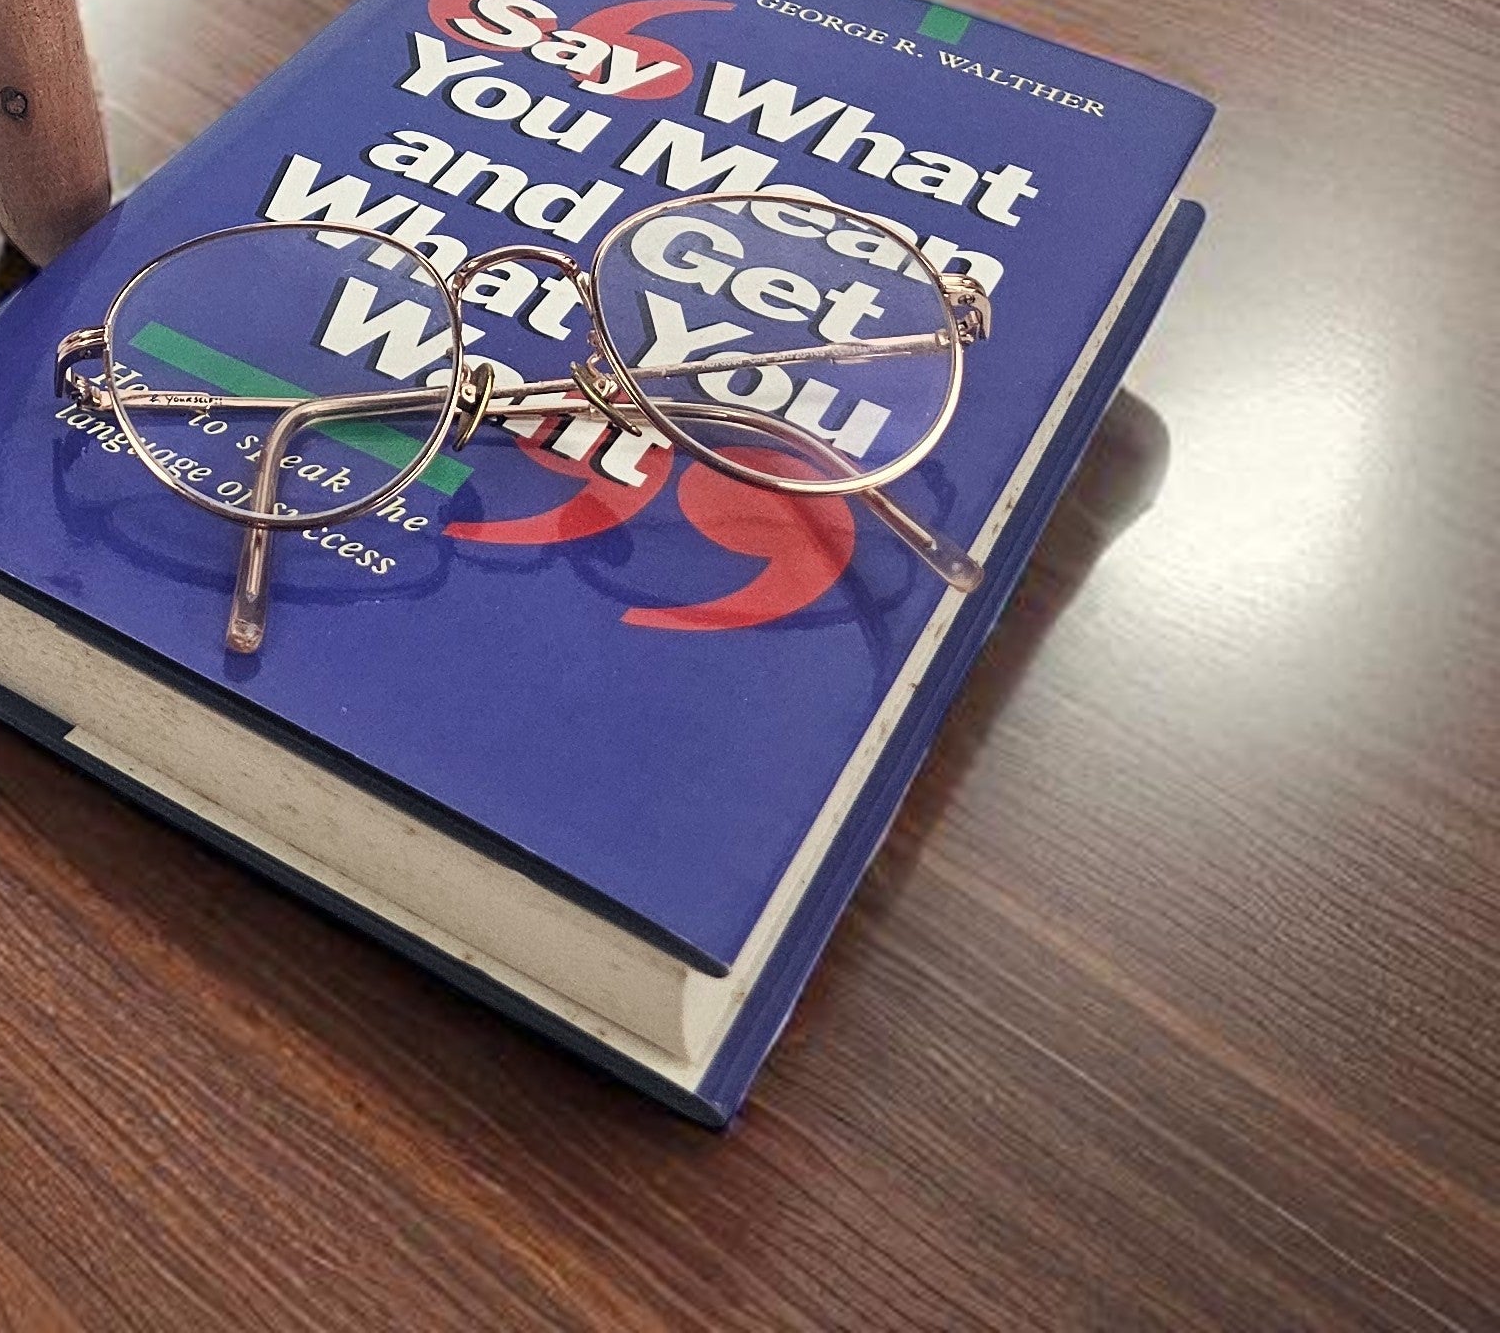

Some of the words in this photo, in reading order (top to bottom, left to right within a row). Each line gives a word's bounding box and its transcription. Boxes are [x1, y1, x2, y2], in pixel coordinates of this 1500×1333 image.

[399, 30, 613, 154] You
[618, 117, 1006, 296] Mean
[702, 60, 1039, 228] What
[891, 36, 925, 59] R.
[937, 49, 1106, 118] WALTHER
[263, 152, 591, 341] What
[636, 289, 894, 459] You
[367, 129, 626, 245] and
[630, 214, 886, 345] Get
[374, 495, 430, 532] he
